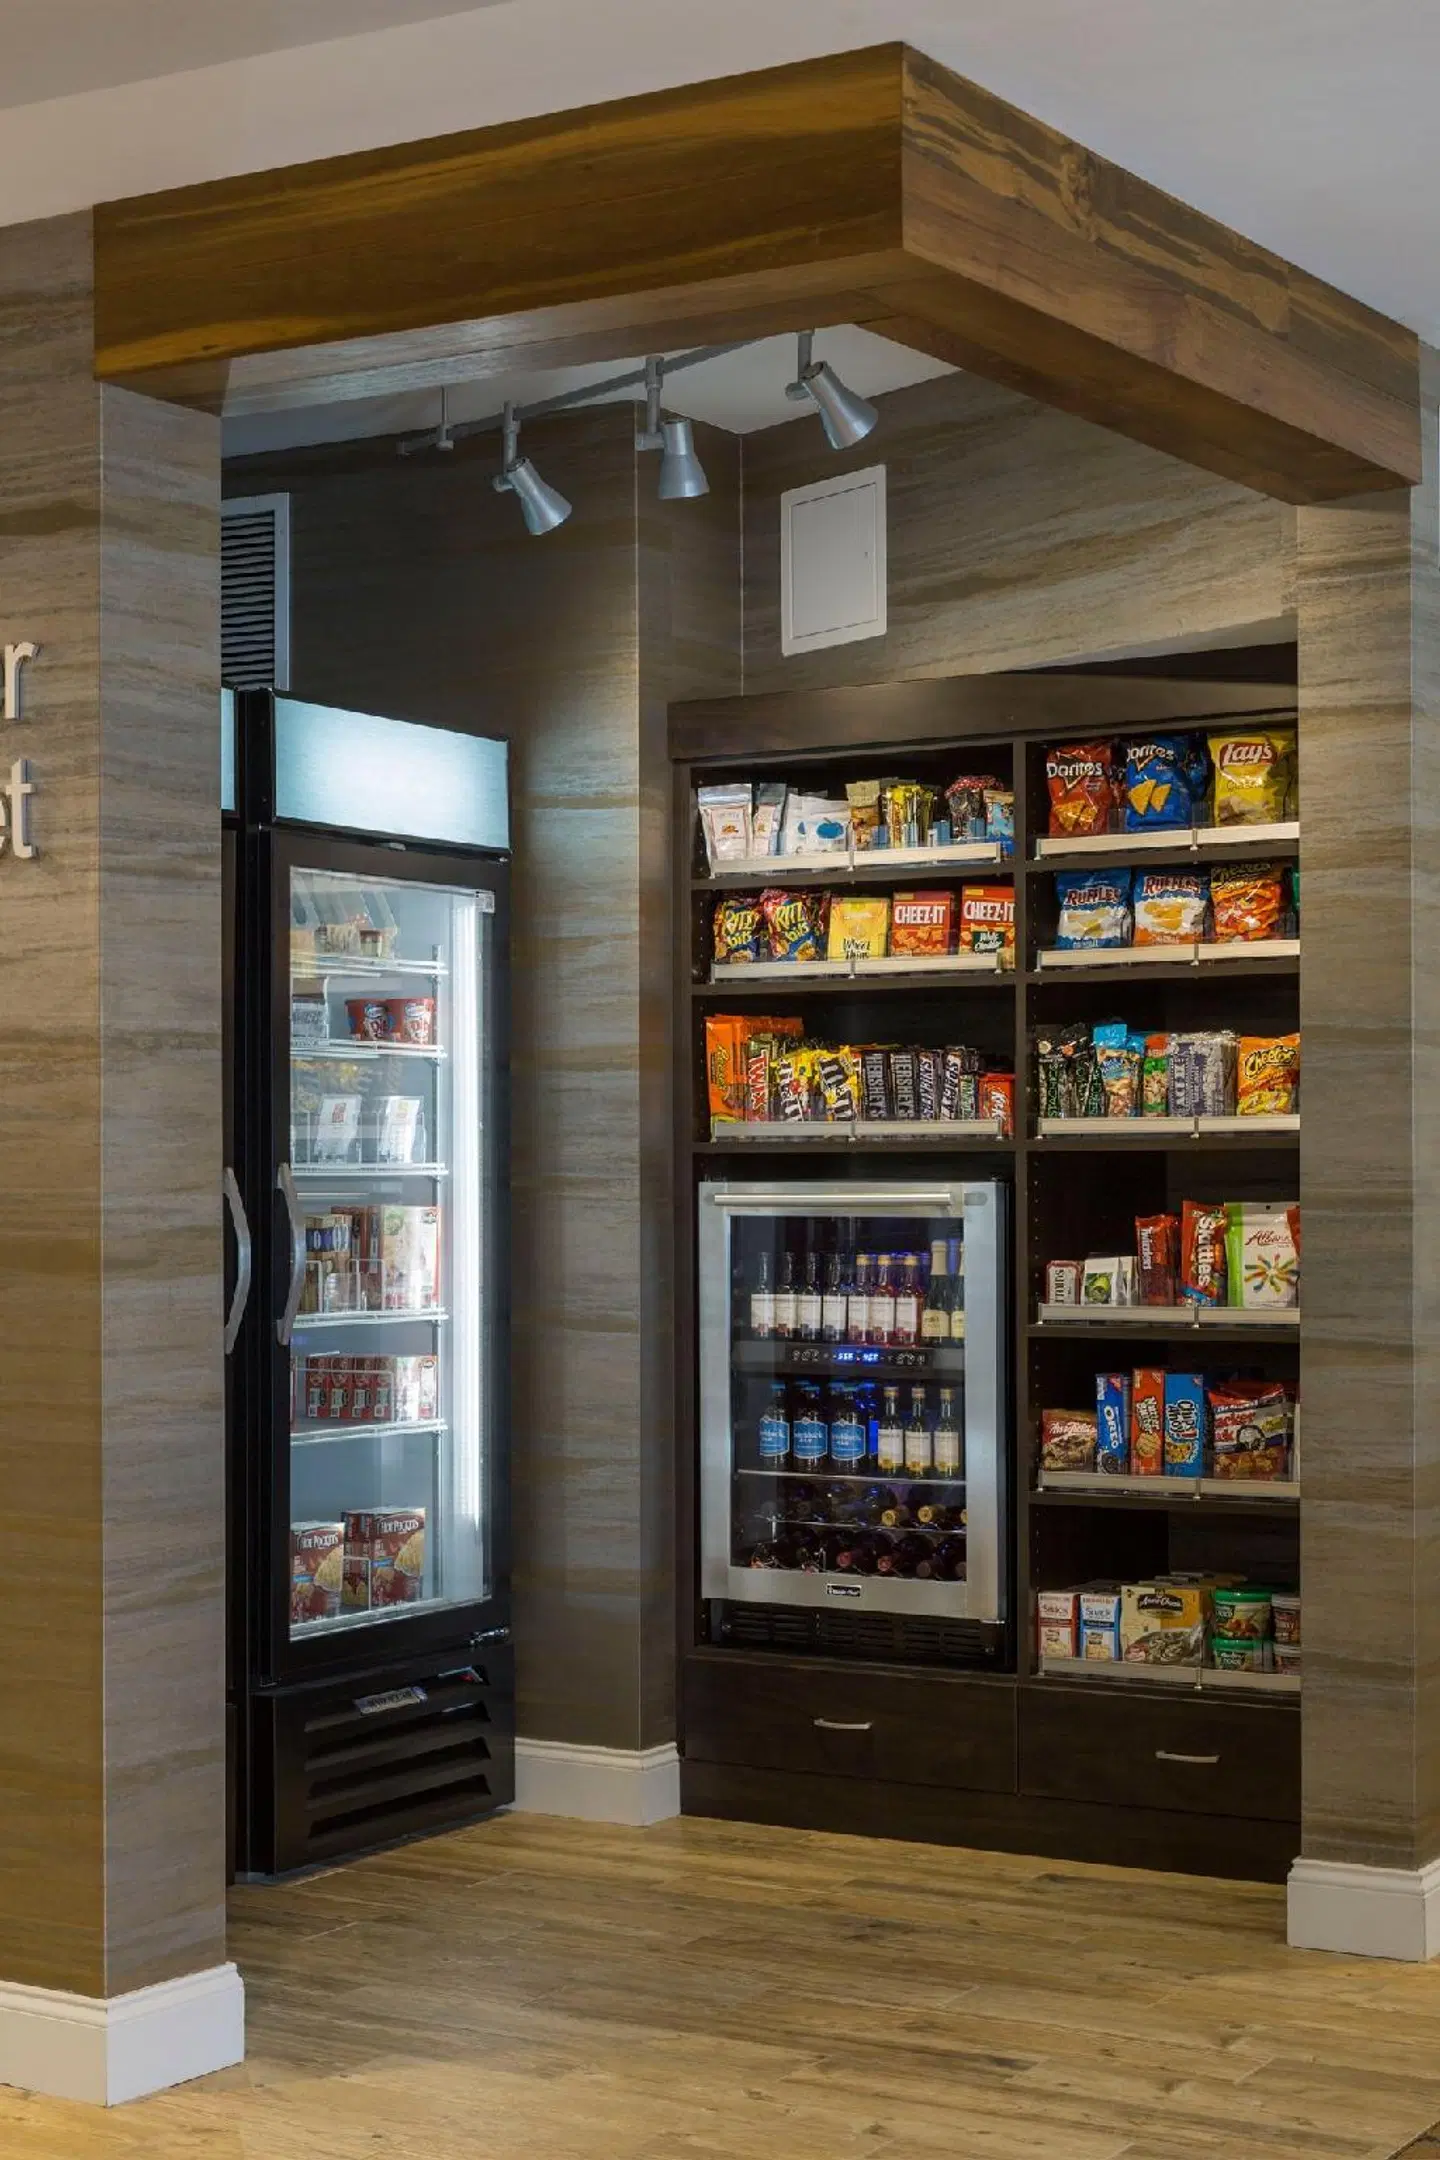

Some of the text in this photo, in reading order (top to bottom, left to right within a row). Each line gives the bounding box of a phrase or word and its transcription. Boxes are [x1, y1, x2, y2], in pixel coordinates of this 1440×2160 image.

[1046, 761, 1103, 779] Doritos
[1222, 742, 1273, 765] Lay's
[894, 905, 946, 925] CHEEZ-IT
[1064, 887, 1121, 905] RUFFLES
[1243, 1045, 1297, 1079] Cheetos
[749, 1052, 767, 1111] TWIX
[865, 1054, 889, 1118] HERSHEY'S
[895, 1053, 915, 1118] HERSHEY'S
[1197, 1215, 1215, 1287] Skittles
[1103, 1405, 1119, 1448] OREO
